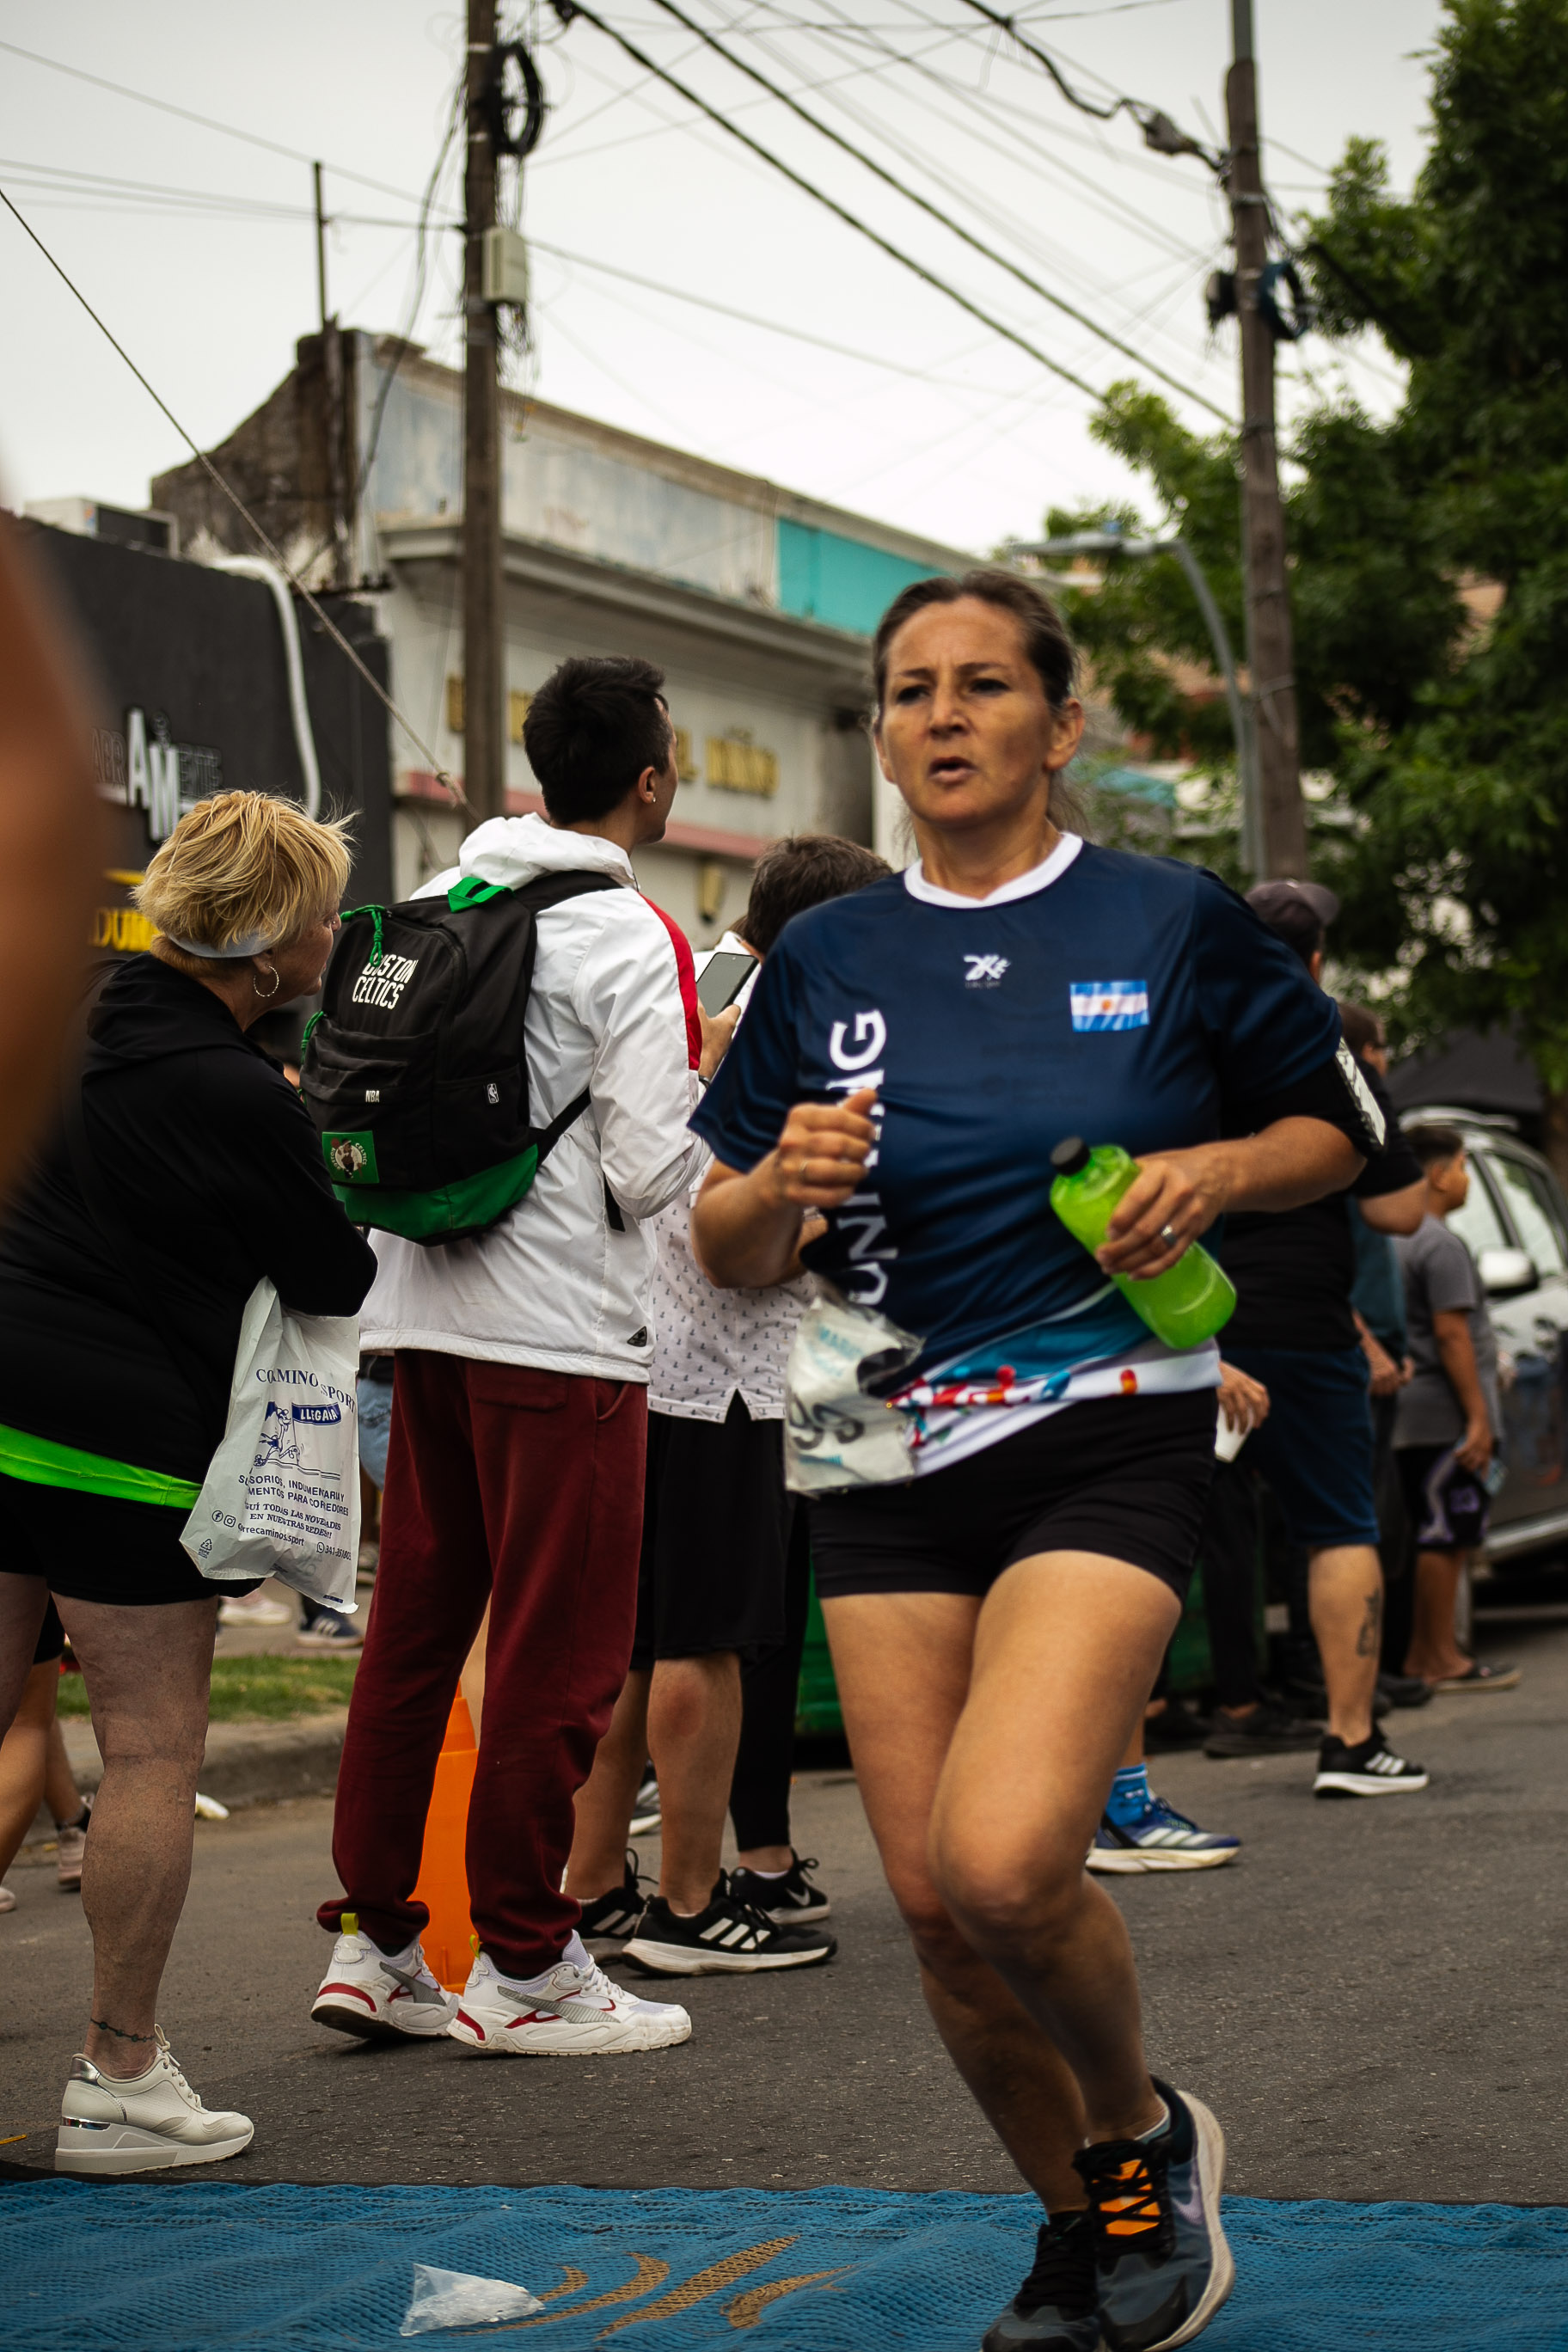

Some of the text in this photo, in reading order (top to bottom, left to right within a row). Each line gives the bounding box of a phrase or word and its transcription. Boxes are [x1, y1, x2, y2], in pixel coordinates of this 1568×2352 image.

[352, 976, 405, 1010] CELTICS
[365, 1090, 380, 1103] NBA
[288, 1491, 309, 1504] PARA
[291, 1510, 303, 1520] LAS
